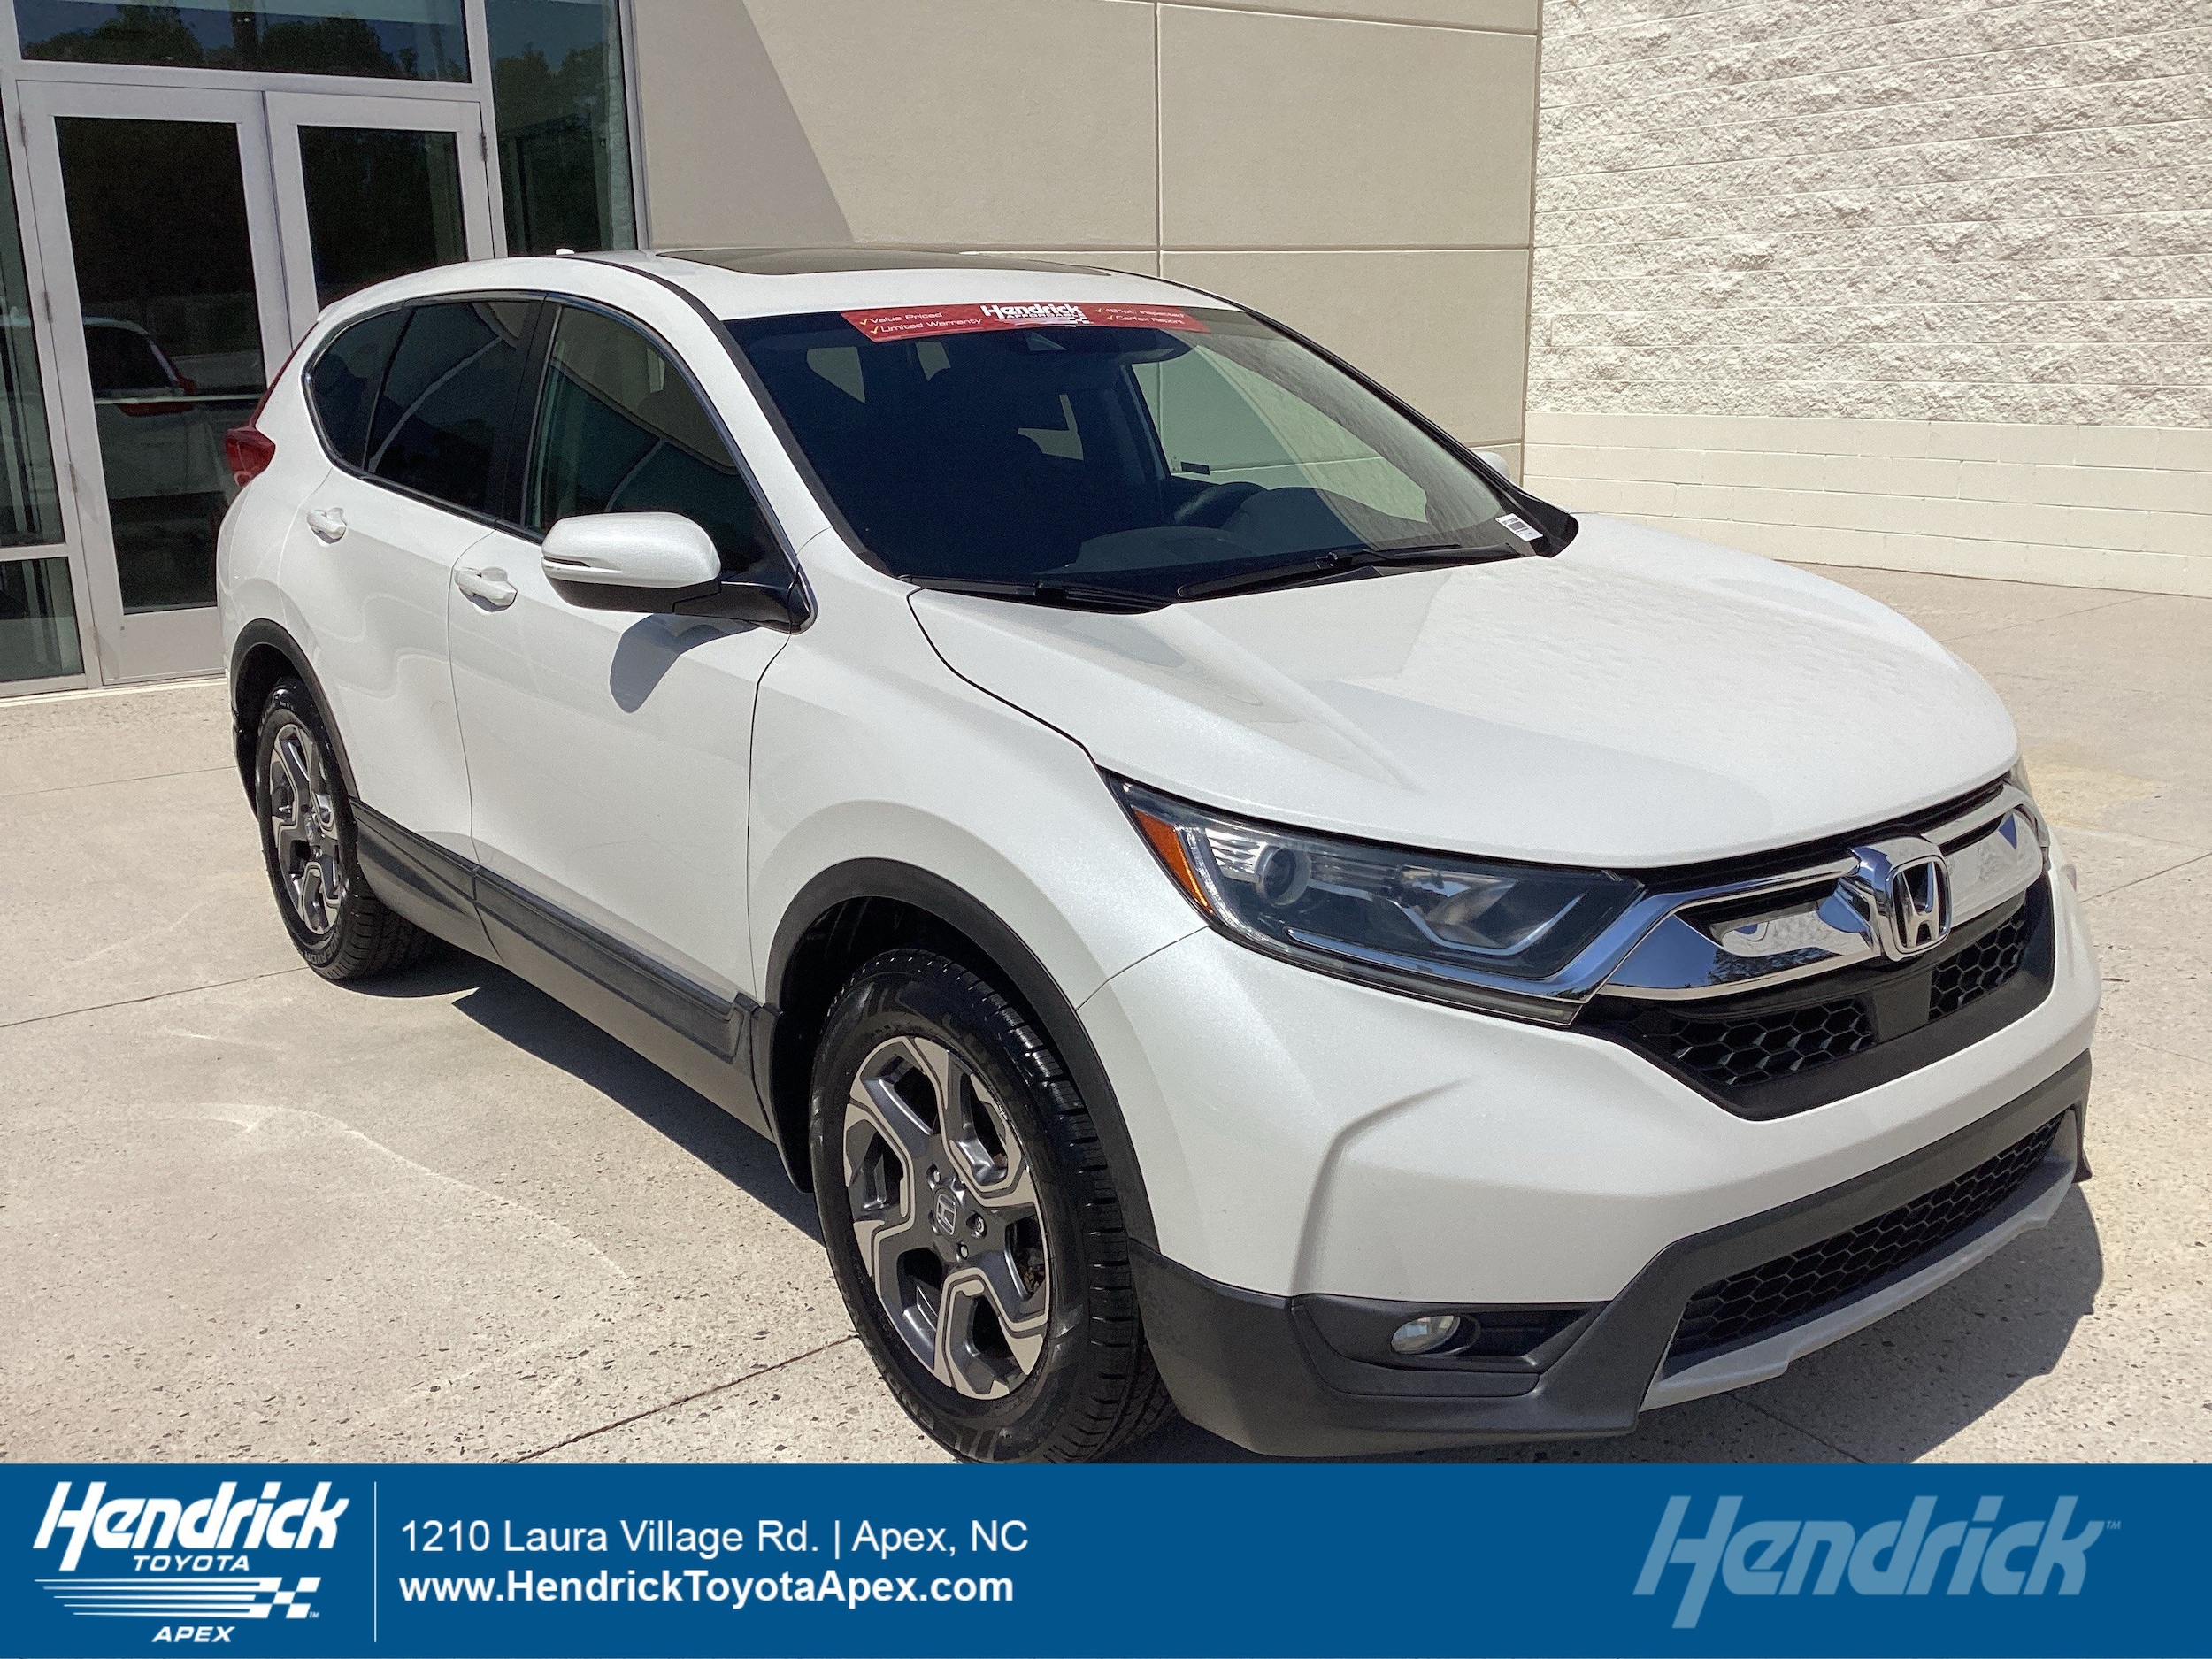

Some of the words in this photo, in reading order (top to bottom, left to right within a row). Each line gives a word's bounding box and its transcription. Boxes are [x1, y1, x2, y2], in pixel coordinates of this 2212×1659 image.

[980, 303, 1082, 319] Hendrick
[869, 315, 902, 324] Value
[880, 322, 924, 333] Limited
